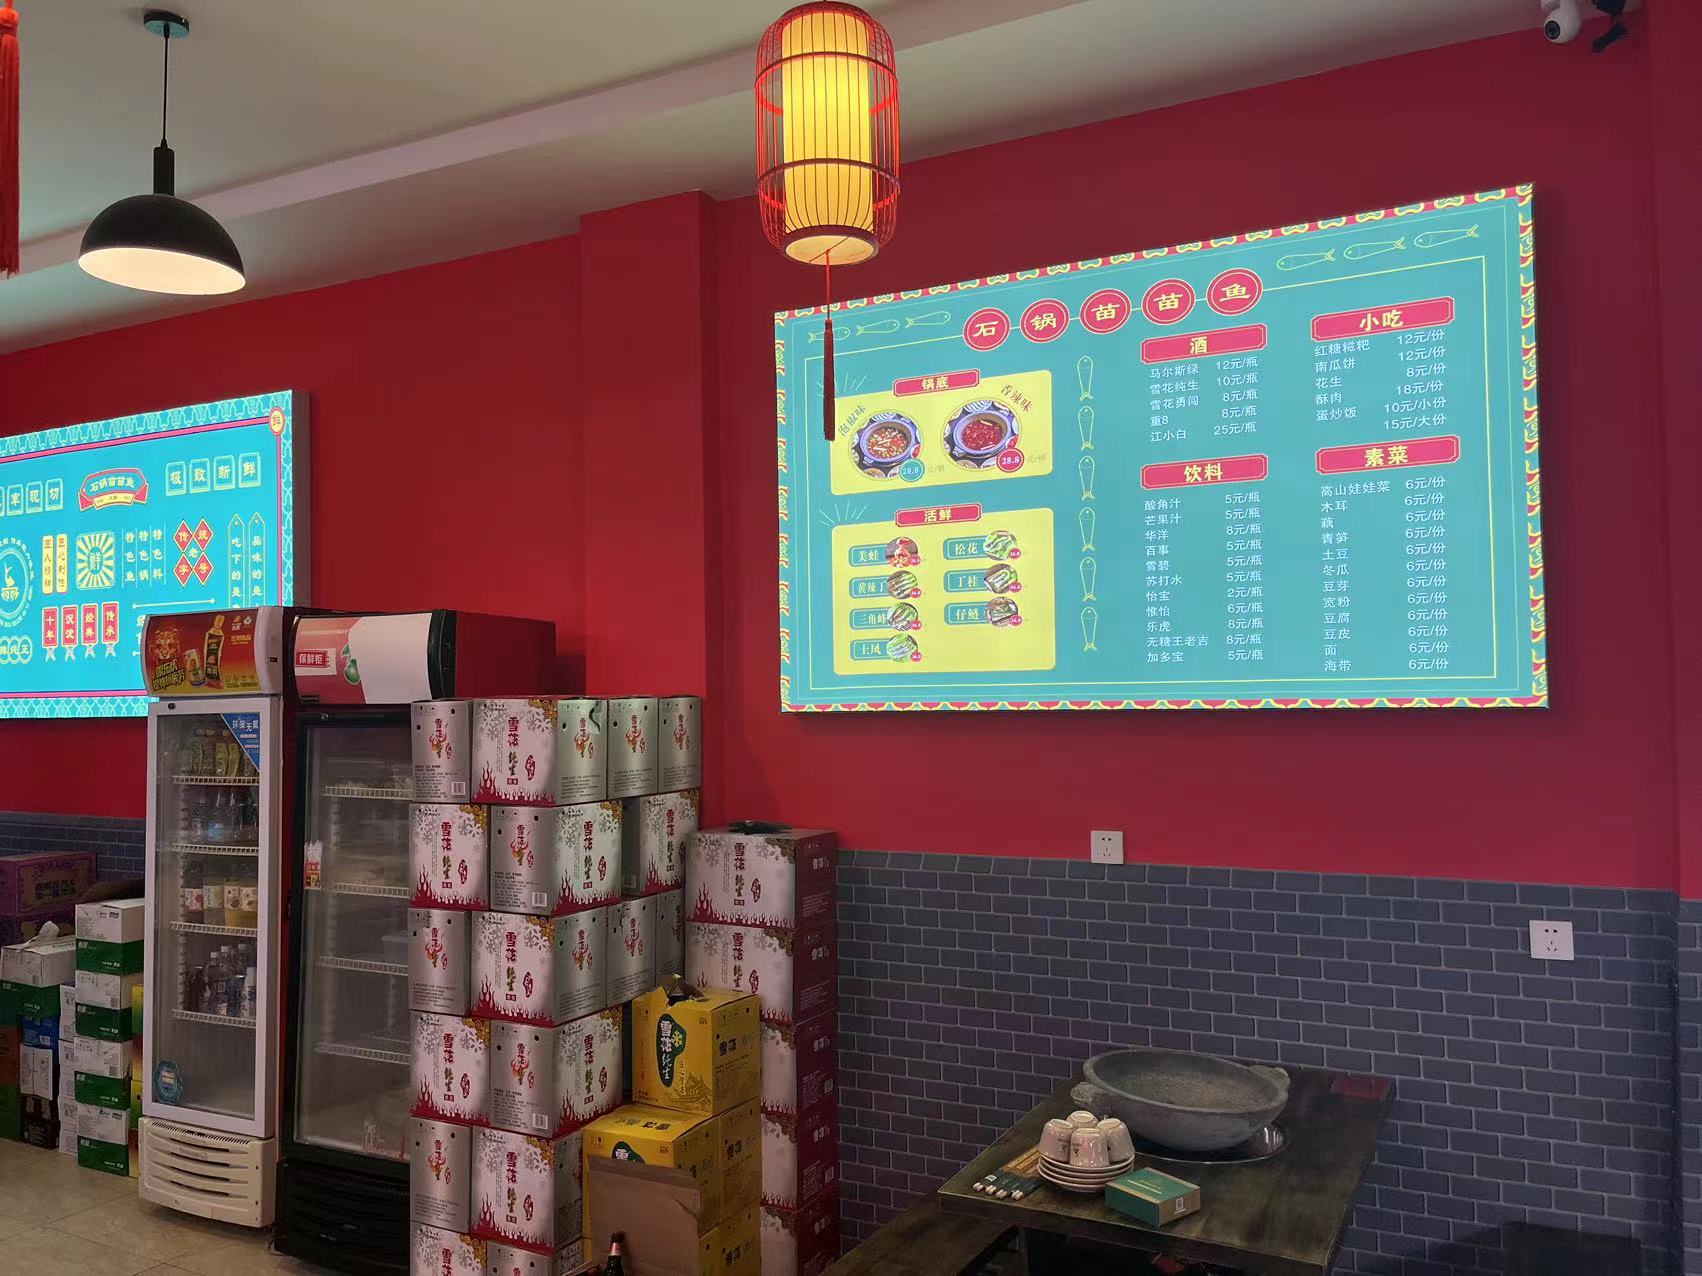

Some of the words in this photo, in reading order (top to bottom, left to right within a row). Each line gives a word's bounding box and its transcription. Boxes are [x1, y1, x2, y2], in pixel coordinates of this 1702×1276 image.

[1360, 309, 1404, 332] 小吃
[1190, 336, 1209, 354] 酒
[1314, 339, 1370, 357] 红糖糍粑
[1397, 329, 1445, 345] 12元/份
[1150, 363, 1199, 379] 马尔斯绿
[1216, 356, 1259, 370] 12元/瓶
[1315, 357, 1356, 373] 南瓜饼
[1398, 346, 1446, 361] 12元/份
[921, 376, 949, 390] 锅底
[1150, 380, 1199, 395] 雪花纯生
[1217, 373, 1259, 387] 10元/瓶
[1315, 376, 1342, 389] 花生
[1407, 363, 1447, 378] 8元/份
[1000, 384, 1032, 412] 香辣味
[1150, 396, 1199, 411] 雪花勇闯
[1223, 389, 1258, 402] 8元/瓶
[1315, 392, 1342, 406] 酥肉
[1396, 380, 1444, 395] 18元/份
[1150, 416, 1169, 427] 重8
[1222, 405, 1257, 419] 8元/瓶
[1316, 407, 1357, 421] 蛋炒饭
[1384, 396, 1447, 413] 10元/小份
[1384, 413, 1447, 430] 15元/大份
[1150, 429, 1187, 443] 江小白
[1214, 422, 1257, 435] 25元/瓶
[1002, 456, 1020, 465] 28.8
[1364, 445, 1409, 468] 素菜
[903, 466, 920, 475] 28.8
[1184, 463, 1224, 483] 饮料
[1321, 480, 1391, 497] 高山娃娃菜
[1406, 476, 1446, 489] 6元/份
[1225, 492, 1261, 504] 5元/瓶
[1321, 500, 1348, 513] 木耳
[1405, 492, 1445, 506] 6元/份
[924, 509, 952, 522] 活鲜
[1145, 513, 1181, 526] 芒果汁
[1226, 508, 1261, 520] 5元/瓶
[1321, 517, 1334, 529] 藕
[1406, 509, 1446, 522] 6元/份
[1227, 524, 1262, 536] 8元/瓶
[1322, 532, 1349, 545] 青笋
[1406, 526, 1446, 539] 6元/份
[955, 543, 978, 555] 松花
[1146, 545, 1170, 556] 百事
[1227, 539, 1262, 551] 5元/瓶
[1323, 549, 1349, 560] 土豆
[1406, 542, 1446, 555] 6元/份
[1146, 560, 1170, 572] 雪碧
[1227, 555, 1263, 567] 5元/瓶
[1323, 564, 1350, 576] 冬瓜
[1407, 559, 1447, 571] 6元/份
[1146, 575, 1182, 587] 苏打水
[1227, 571, 1262, 583] 5元/瓶
[1323, 580, 1350, 592] 豆芽
[1407, 575, 1447, 588] 6元/份
[1146, 591, 1170, 602] 怡宝
[1228, 587, 1263, 598] 2元/瓶
[1324, 596, 1351, 608] 宽粉
[1408, 592, 1447, 604] 6元/份
[1228, 602, 1264, 614] 6元/瓶
[1324, 613, 1351, 624] 豆腐
[1408, 609, 1448, 621] 6元/份
[1147, 621, 1171, 632] 乐虎
[1228, 618, 1264, 629] 8元/瓶
[1325, 628, 1351, 640] 豆皮
[1408, 625, 1448, 637] 6元/份
[1147, 635, 1209, 647] 无糖王老吉
[1227, 634, 1262, 645] 8元/瓶
[1325, 645, 1337, 656] 面
[1409, 642, 1450, 654] 6元/份
[300, 653, 323, 665] 保鲜柜
[1147, 652, 1184, 663] 加多宝
[1228, 650, 1263, 661] 5元/瓶
[1324, 660, 1351, 672] 海带
[1409, 658, 1449, 670] 6元/份
